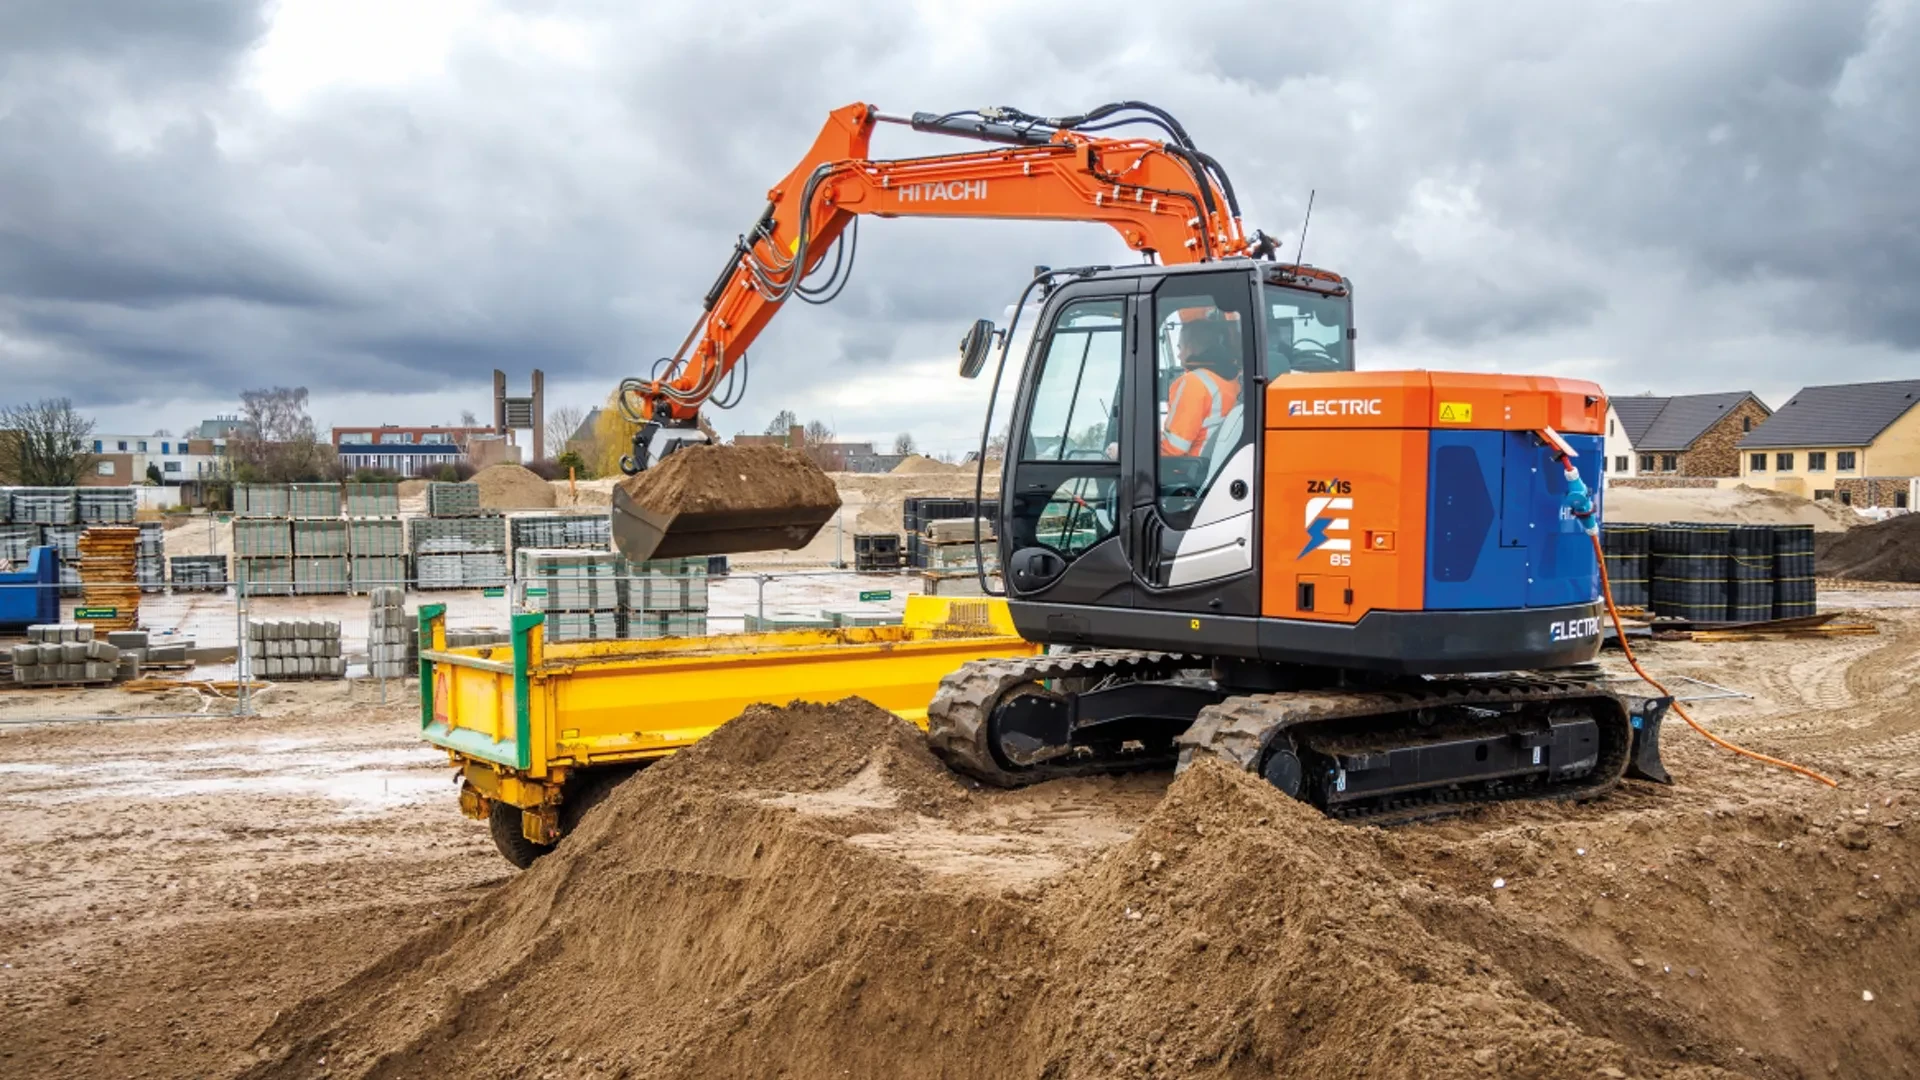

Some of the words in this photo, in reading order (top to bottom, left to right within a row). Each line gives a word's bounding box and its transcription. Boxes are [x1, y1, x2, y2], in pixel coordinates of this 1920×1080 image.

[898, 181, 988, 202] HITACHI
[1288, 399, 1382, 416] ELECTRIC
[1307, 478, 1351, 493] ZAXIS
[1330, 553, 1351, 566] 85
